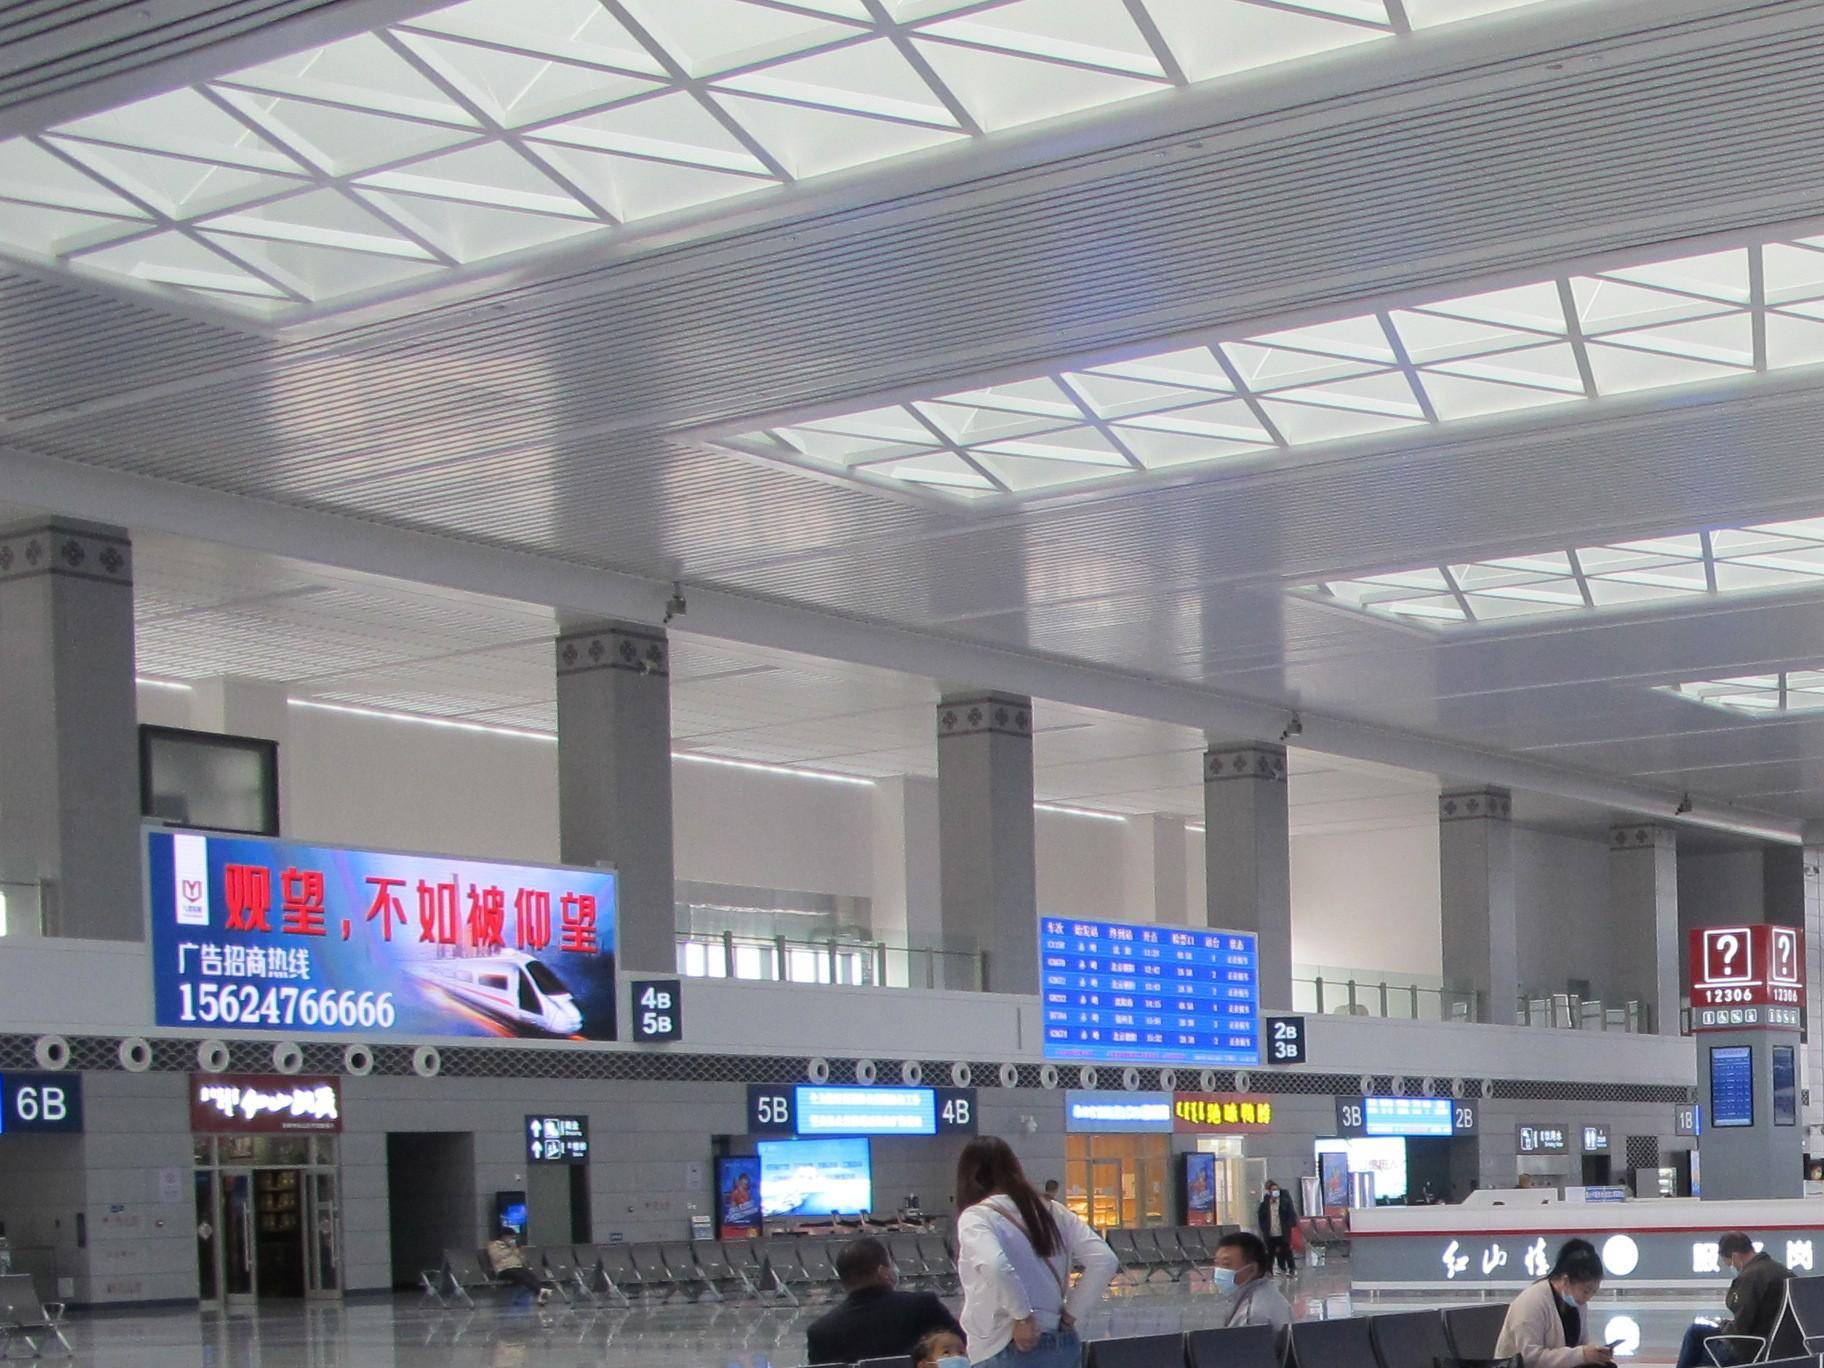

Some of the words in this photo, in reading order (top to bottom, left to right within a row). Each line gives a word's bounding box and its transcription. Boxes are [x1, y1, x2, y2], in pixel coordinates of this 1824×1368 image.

[179, 943, 311, 980] 广告招商热线
[179, 983, 395, 1028] 15624766666
[641, 987, 671, 1009] 4B
[1706, 989, 1752, 1003] 12306
[1774, 989, 1798, 1003] 12306
[642, 1013, 672, 1034] 5B
[1274, 1023, 1297, 1039] 2B
[1275, 1043, 1298, 1058] 3B
[17, 1087, 66, 1120] 6B
[758, 1097, 788, 1123] 5B
[942, 1099, 970, 1124] 4B
[1343, 1106, 1362, 1126] 3B
[1455, 1108, 1473, 1128] 2B
[1680, 1111, 1693, 1129] 1B
